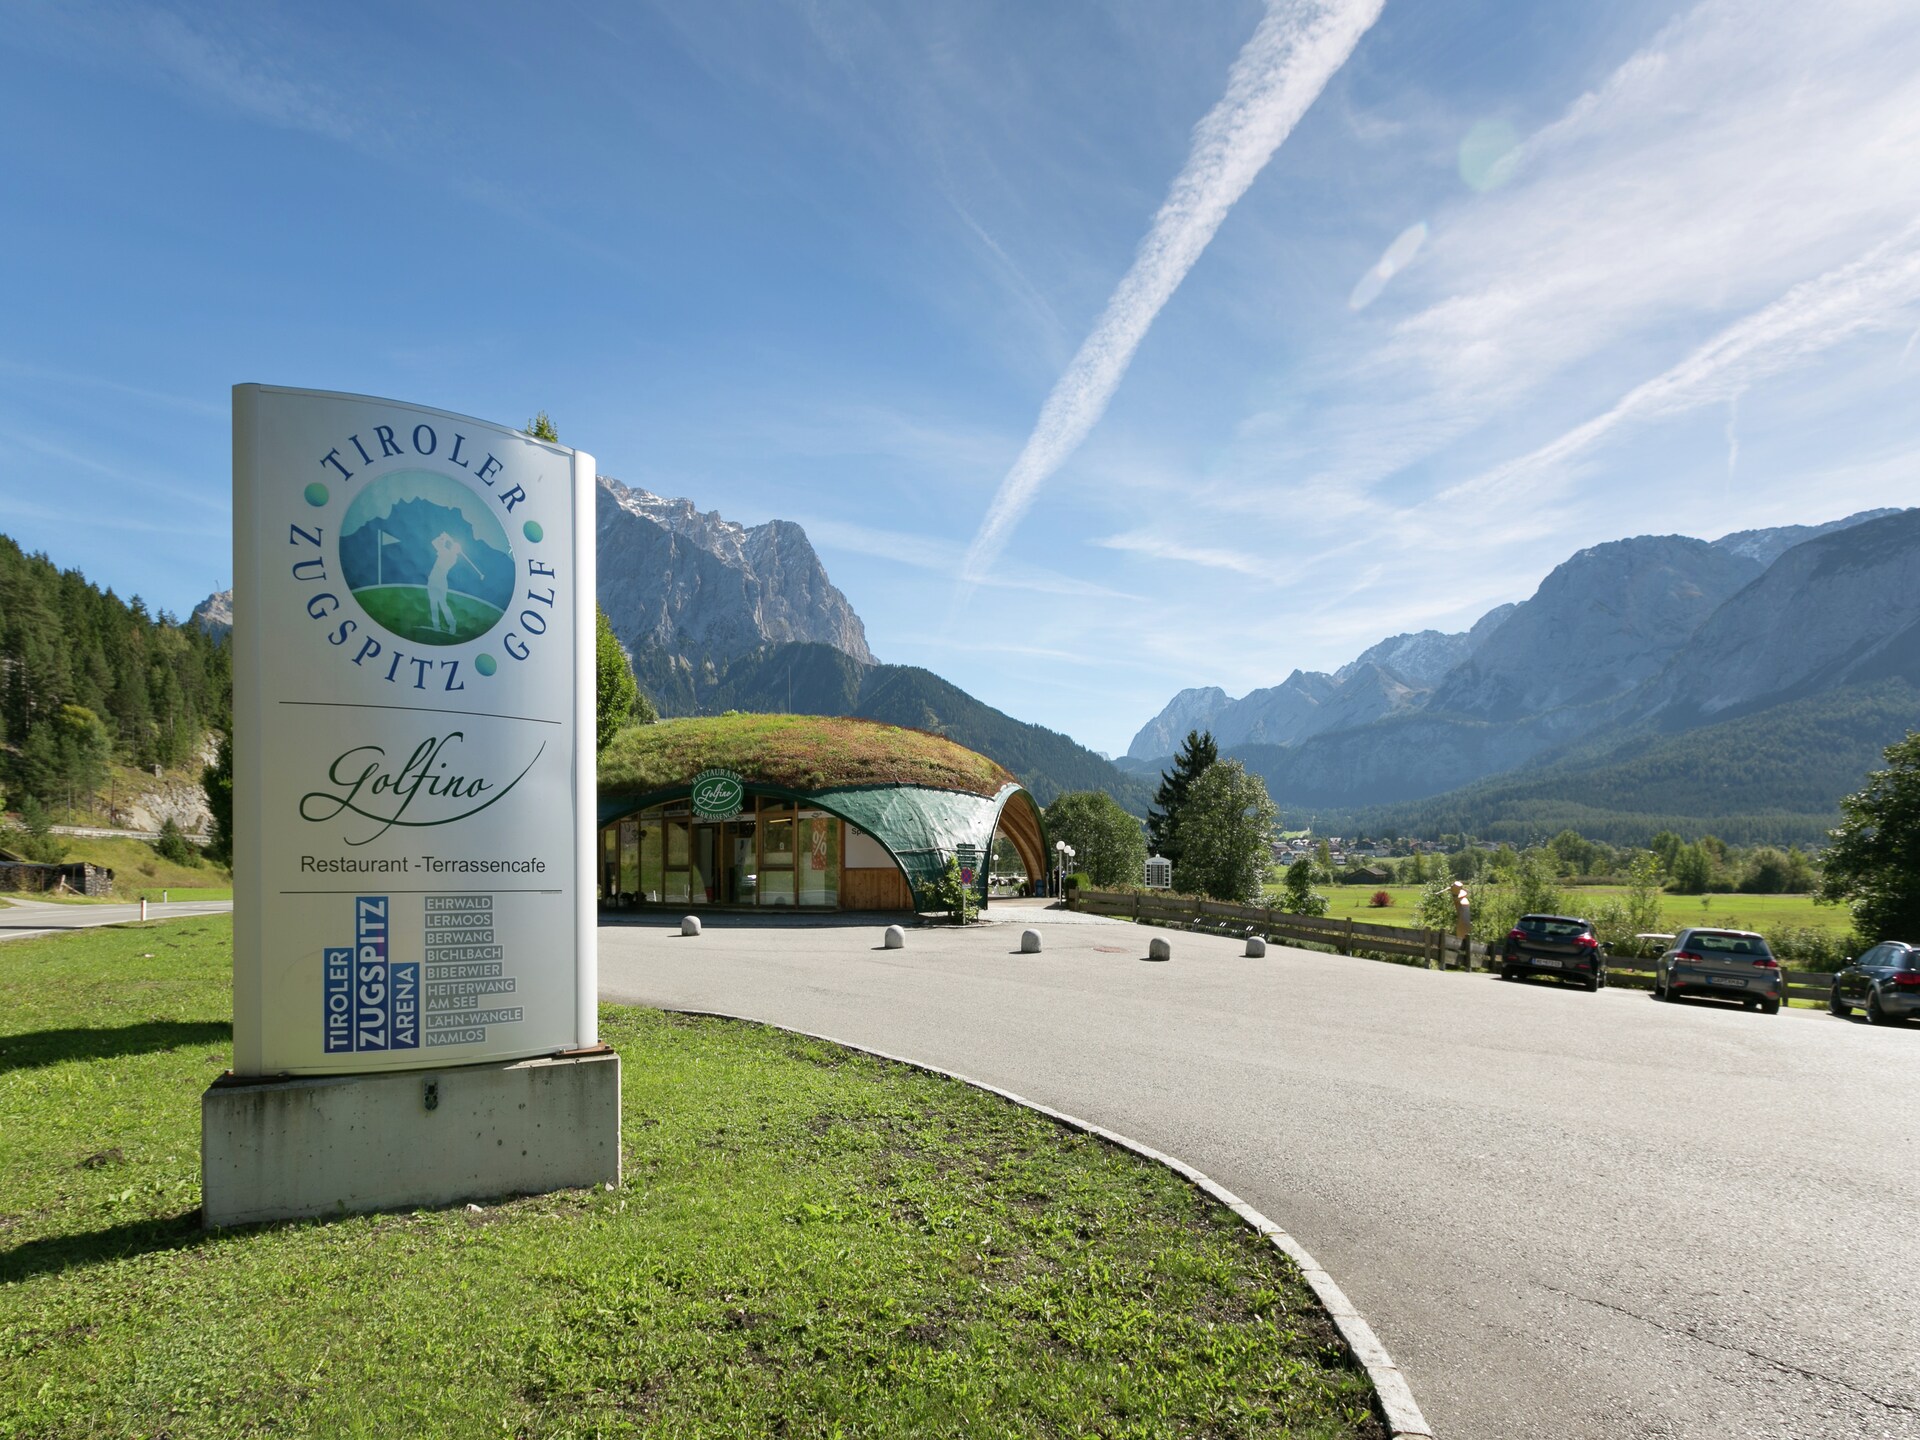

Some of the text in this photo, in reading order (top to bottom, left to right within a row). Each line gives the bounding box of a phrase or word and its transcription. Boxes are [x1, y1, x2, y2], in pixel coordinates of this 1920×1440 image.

[320, 424, 526, 513] TIROLER
[290, 523, 464, 691] ZUGSPITZ
[503, 558, 555, 661] GOLF
[691, 768, 743, 785] RESTAURANT
[299, 731, 546, 845] Golfino
[697, 781, 739, 809] Golfino
[692, 804, 743, 821] TERRASSENCAFE
[301, 856, 408, 873] Restaurant
[427, 898, 491, 909] EHRWALD
[427, 914, 491, 926] LERMOOS
[427, 931, 492, 944] BERWANG
[427, 947, 501, 961] BICHLBACH
[359, 900, 385, 1047] ZUGSPITZ
[427, 964, 500, 978] BIBERWIER
[428, 980, 514, 995] HEITERWANG
[329, 951, 348, 1049] TIROLER
[396, 966, 414, 1045] ARENA
[428, 995, 476, 1009] AM SEE
[427, 1009, 521, 1027] LÄHN-WÄNGLE
[427, 1030, 483, 1045] NAMLOS
